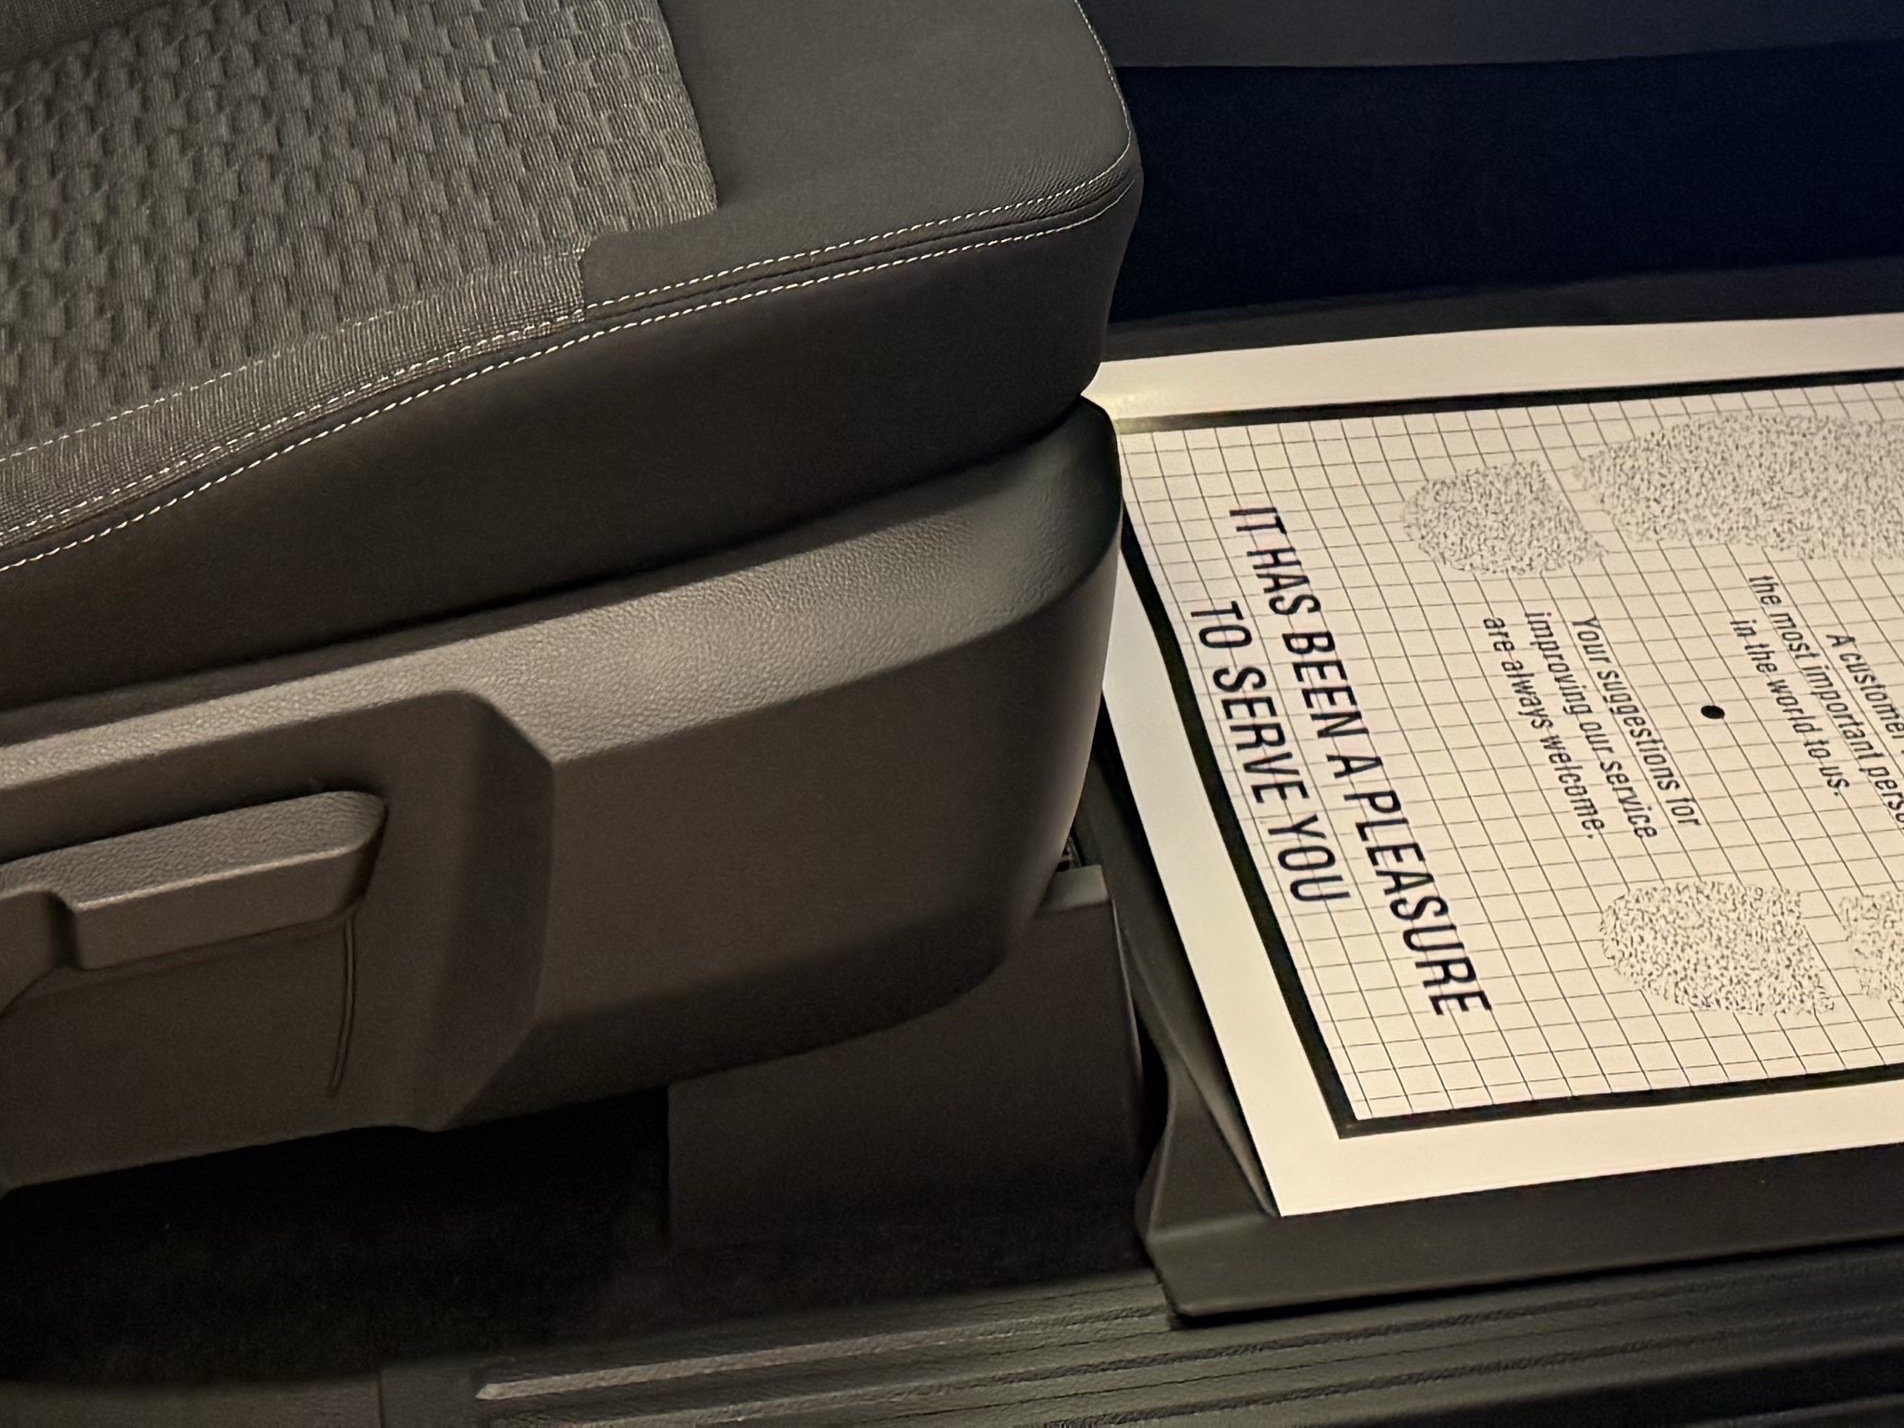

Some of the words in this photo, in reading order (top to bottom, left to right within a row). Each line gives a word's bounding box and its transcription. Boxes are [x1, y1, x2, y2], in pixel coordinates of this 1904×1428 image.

[1229, 506, 1287, 535] IT
[1246, 546, 1321, 616] HAS
[1190, 601, 1252, 649] TO
[1282, 630, 1369, 740] BEEN
[1749, 575, 1782, 606] the
[1769, 612, 1819, 660] most
[1801, 664, 1884, 761] important
[1826, 634, 1856, 647] A
[1212, 666, 1309, 804] SERVE
[1327, 754, 1383, 779] A
[1483, 617, 1515, 652] are
[1501, 660, 1553, 730] always
[1539, 733, 1605, 839] welcome.
[1524, 611, 1593, 715] improving
[1579, 721, 1614, 754] our
[1599, 760, 1657, 839] service
[1572, 616, 1612, 664] Your
[1597, 669, 1681, 791] suggestions
[1665, 796, 1702, 826] for
[1730, 619, 1757, 637] in
[1744, 643, 1778, 674] the
[1766, 679, 1823, 734] world
[1803, 739, 1831, 759] to
[1819, 766, 1850, 796] us.
[1267, 814, 1352, 903] YOU
[1344, 789, 1492, 1016] PLEASURE
